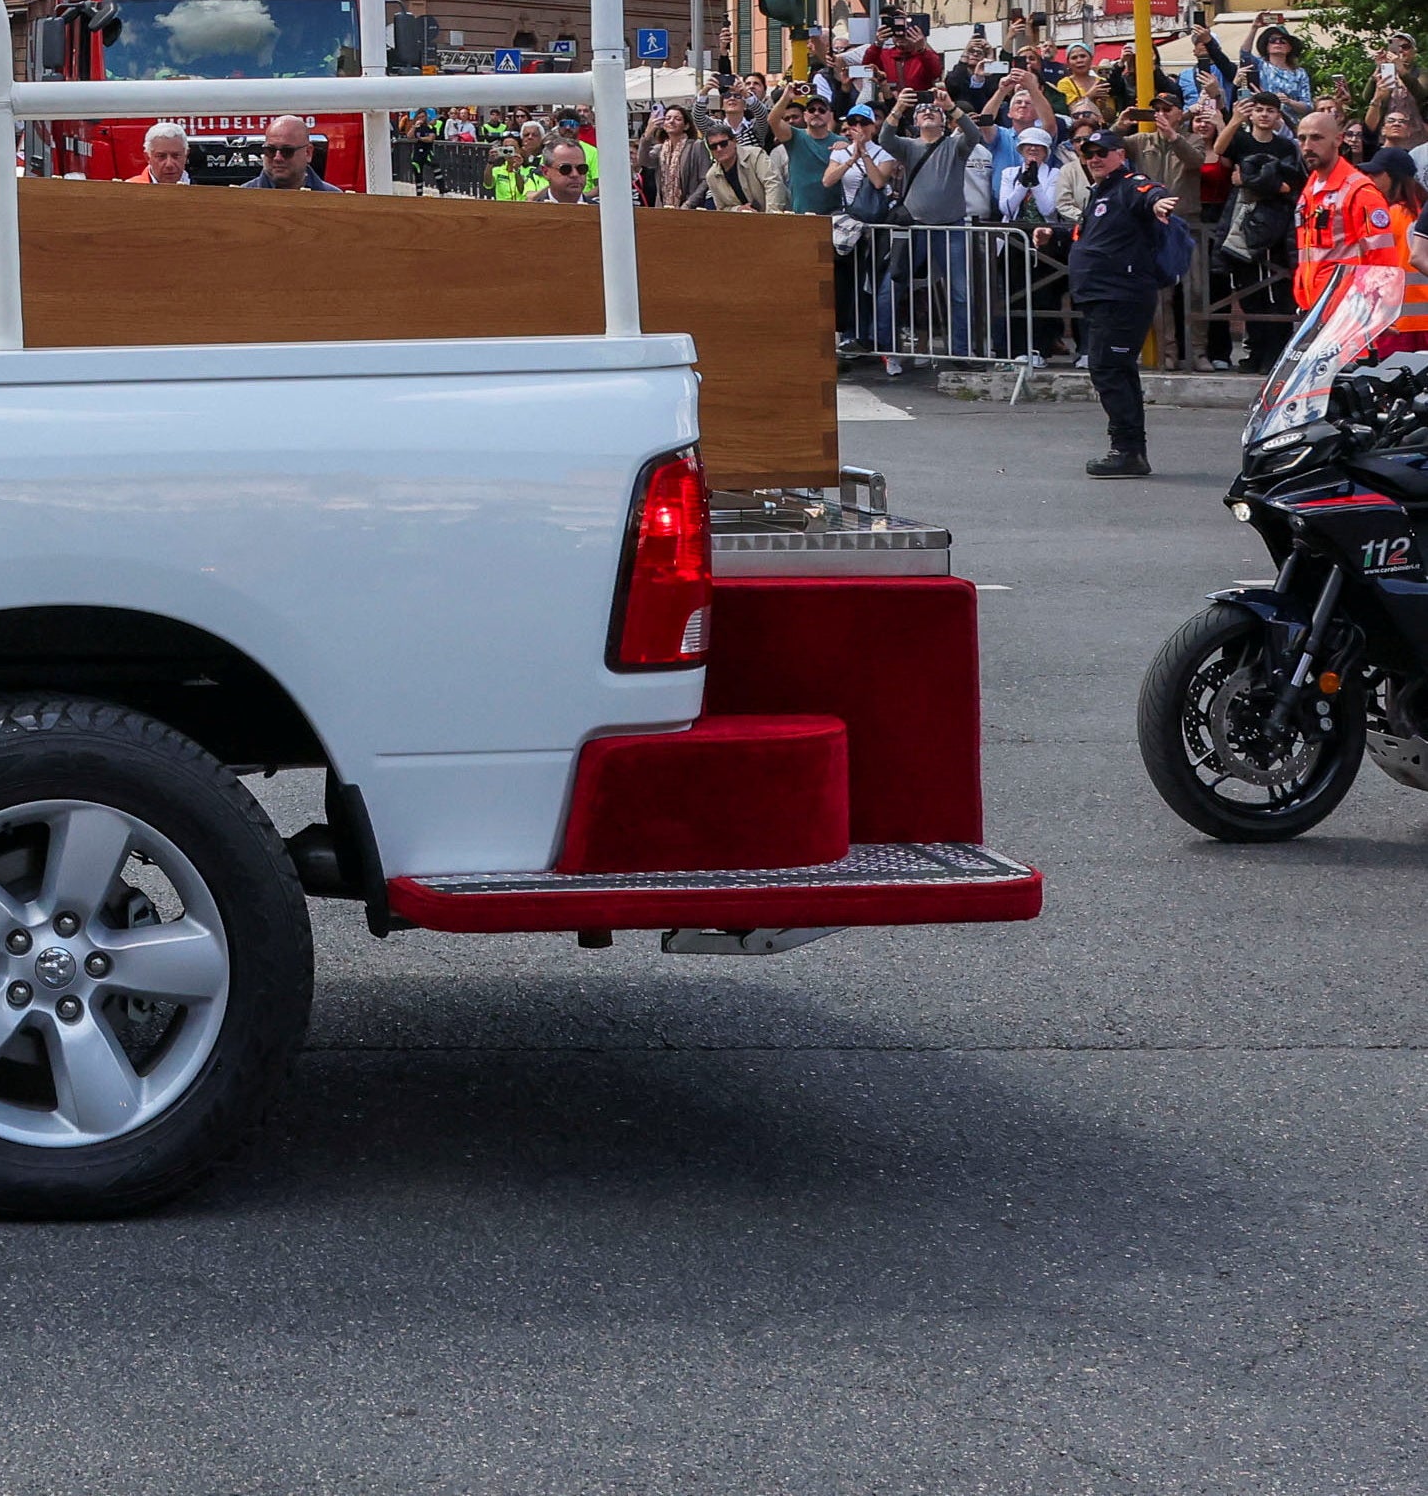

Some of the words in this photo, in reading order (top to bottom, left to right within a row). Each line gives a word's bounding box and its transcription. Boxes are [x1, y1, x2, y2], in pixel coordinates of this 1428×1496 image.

[219, 116, 255, 129] DEL
[206, 153, 265, 168] MAN
[1360, 536, 1411, 568] 112
